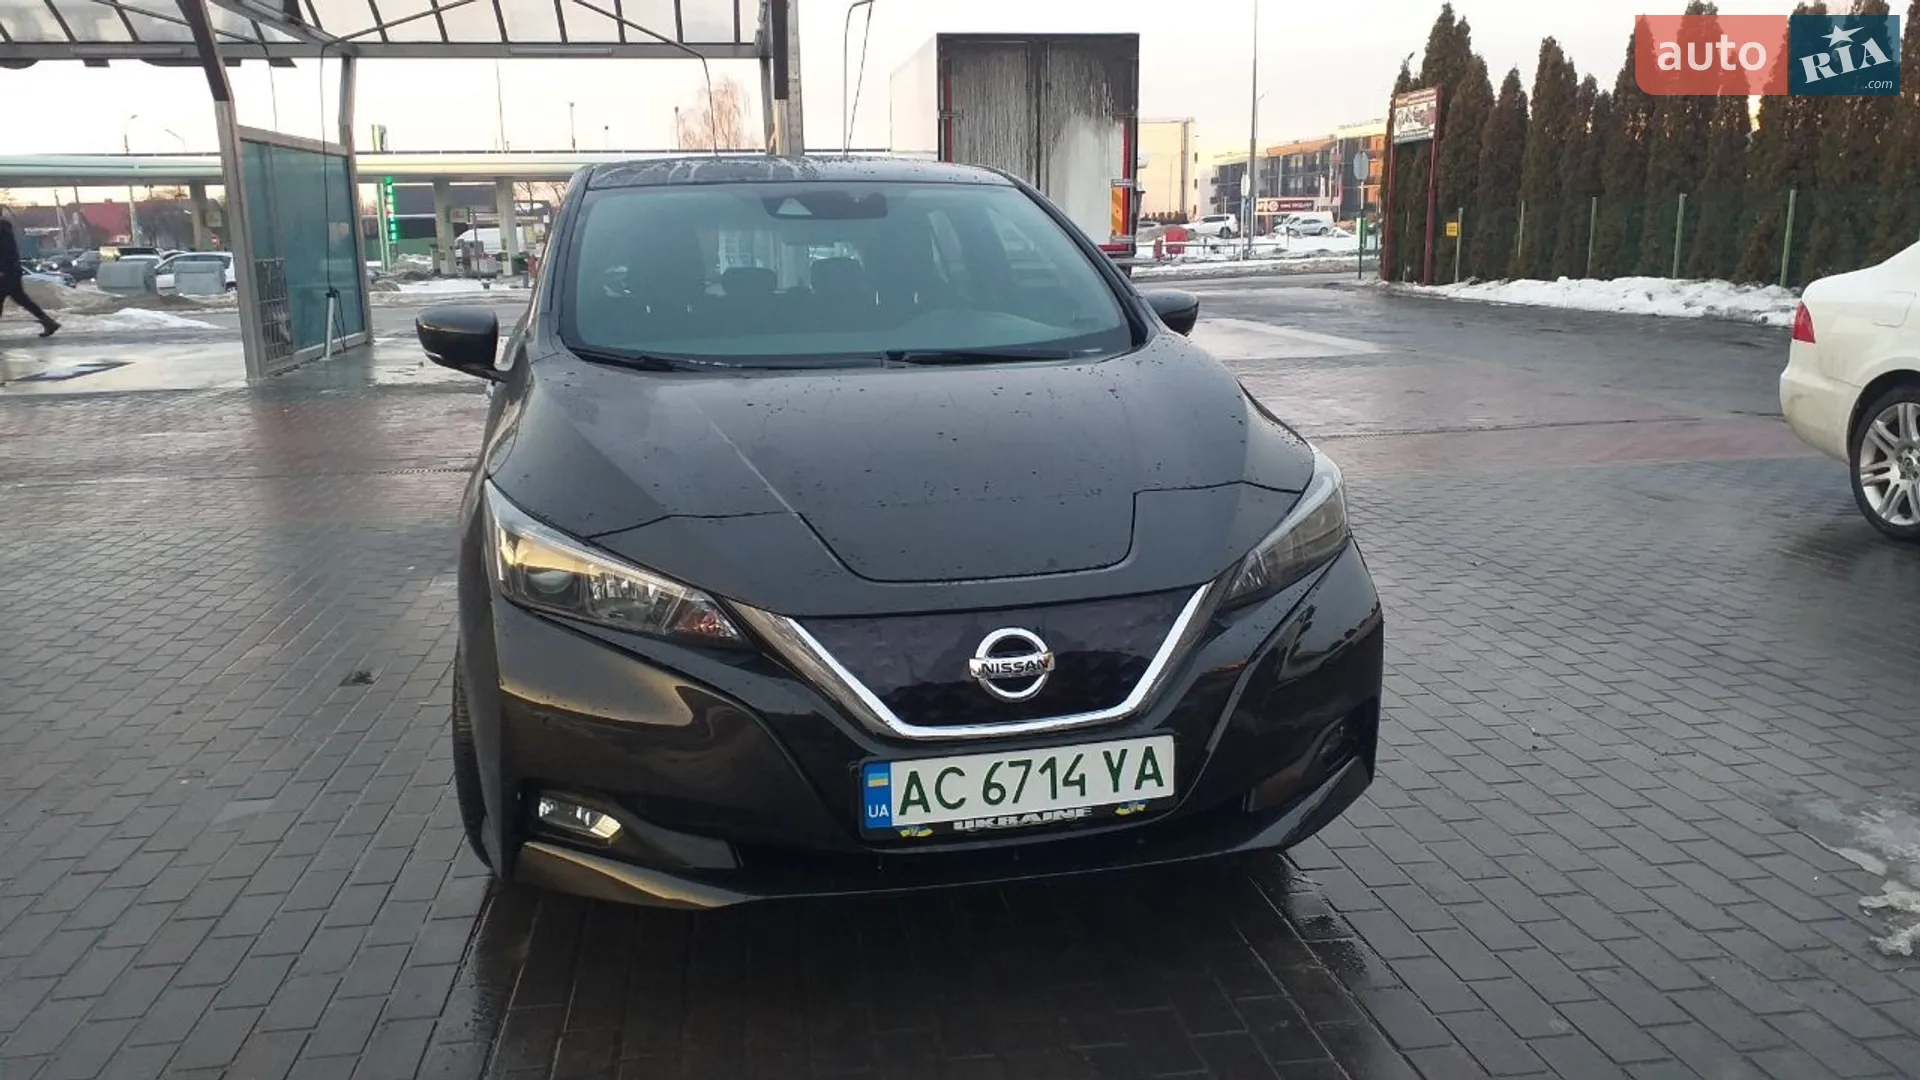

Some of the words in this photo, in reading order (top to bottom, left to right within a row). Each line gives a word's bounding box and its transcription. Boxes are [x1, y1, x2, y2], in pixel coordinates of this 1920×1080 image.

[981, 657, 1050, 674] NISSAN
[899, 767, 967, 816] AC
[982, 753, 1086, 805] 6714
[1103, 746, 1164, 793] YA
[868, 804, 889, 818] UA
[953, 806, 1092, 832] UKRAINE
